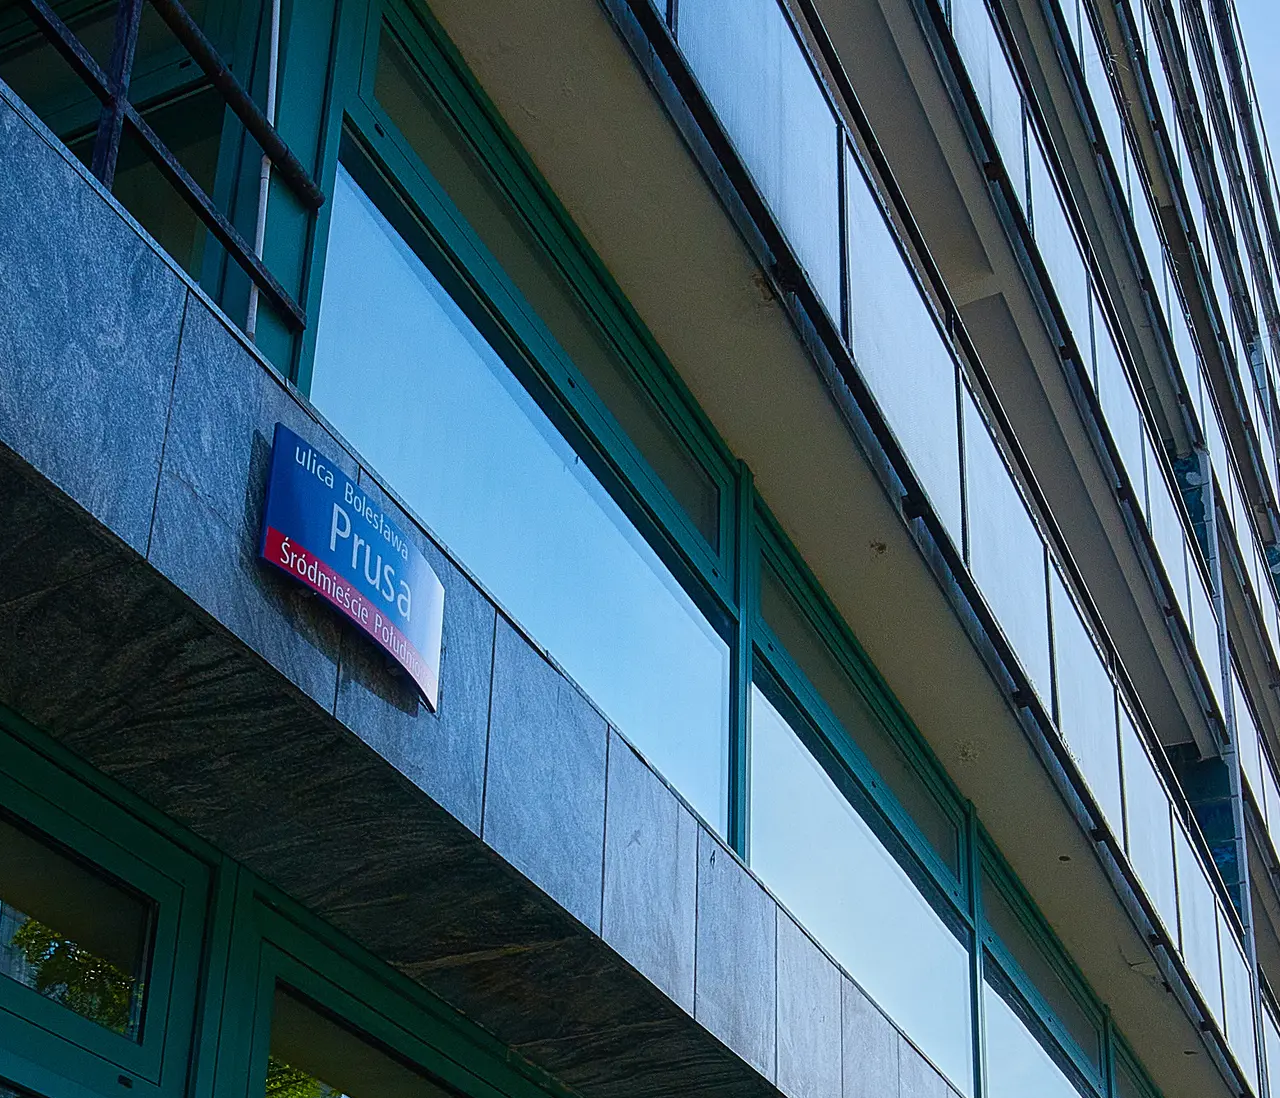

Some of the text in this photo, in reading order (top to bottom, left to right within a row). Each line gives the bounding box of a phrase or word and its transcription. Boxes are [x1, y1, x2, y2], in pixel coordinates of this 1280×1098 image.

[295, 446, 408, 561] ulica Bolesława
[280, 536, 368, 624] Śródmieście
[329, 502, 411, 622] Prusa
